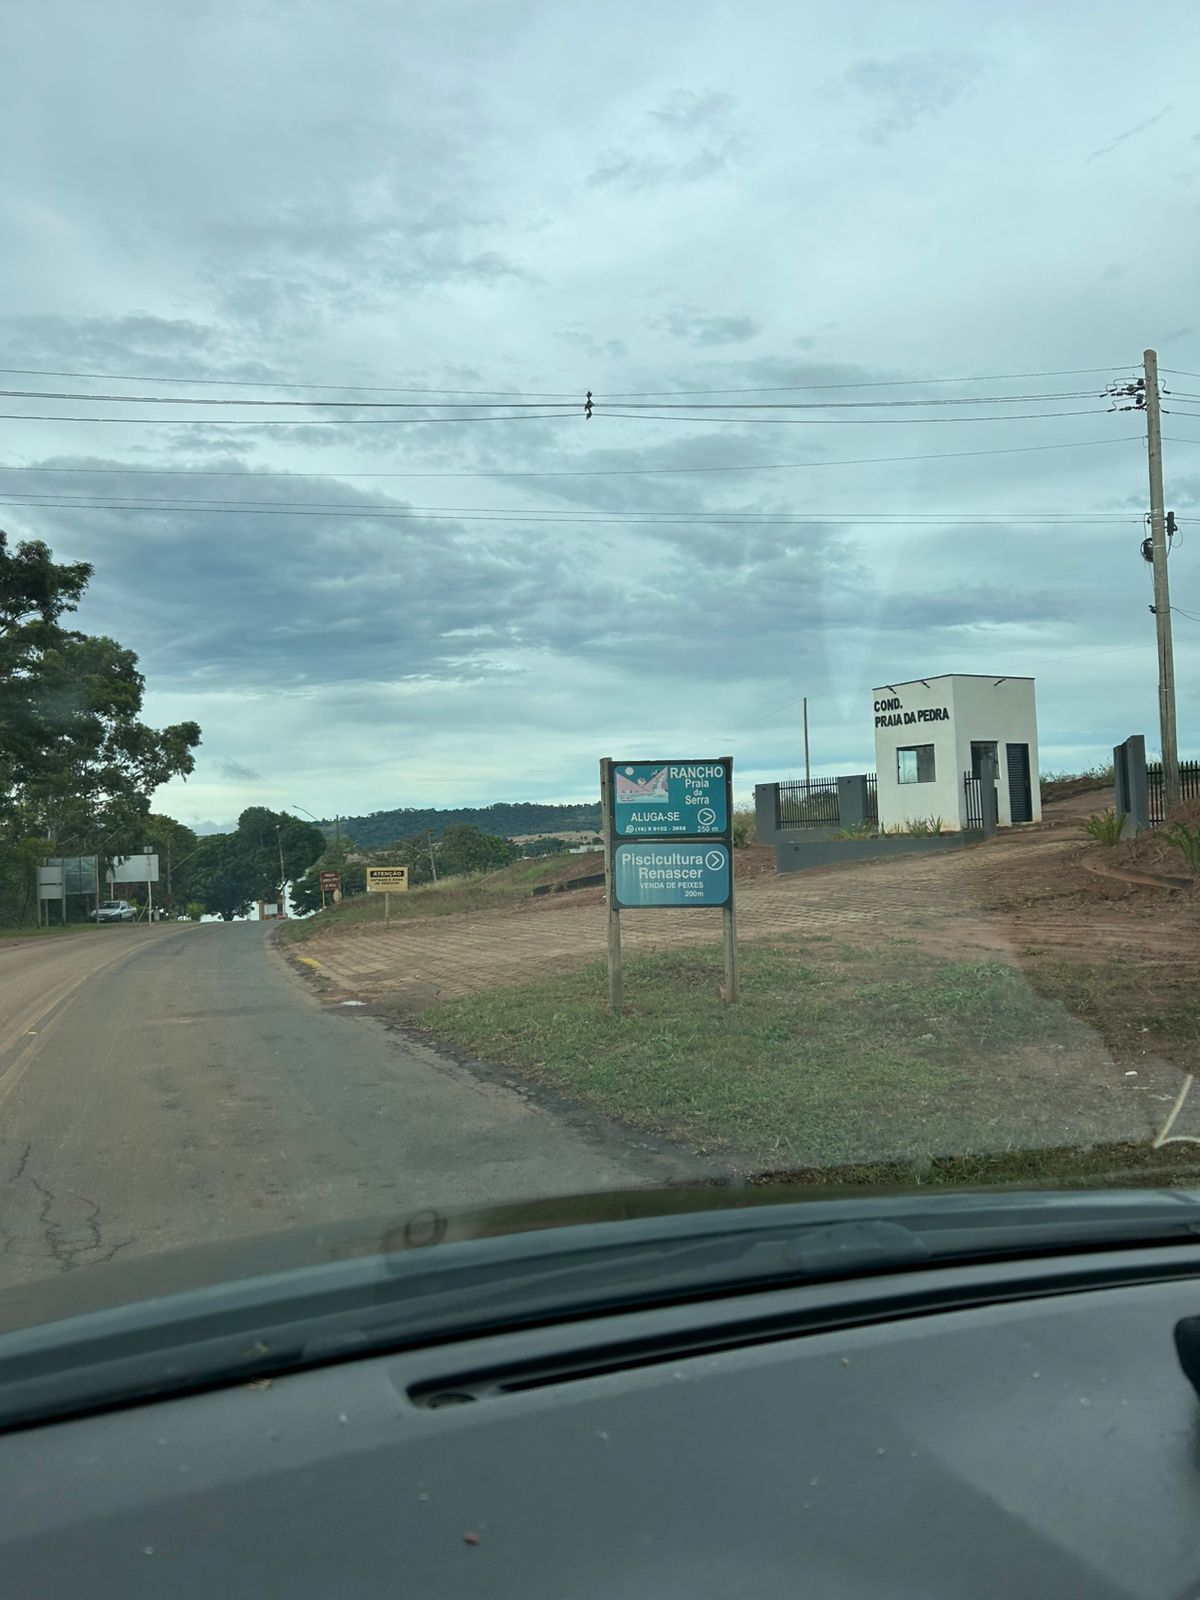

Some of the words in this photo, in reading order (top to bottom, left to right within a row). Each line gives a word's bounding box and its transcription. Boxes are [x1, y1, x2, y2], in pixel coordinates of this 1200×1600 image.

[874, 698, 903, 712] COND.
[875, 713, 903, 728] PRAIA
[903, 711, 917, 725] DA
[917, 707, 950, 722] PEDRA
[670, 766, 723, 778] RANCHO
[685, 779, 709, 788] Praia
[685, 796, 709, 805] Serra
[631, 812, 680, 822] ALUGA-SE
[697, 825, 710, 833] 250
[622, 853, 703, 865] Piscicultura
[639, 867, 703, 879] Renascer
